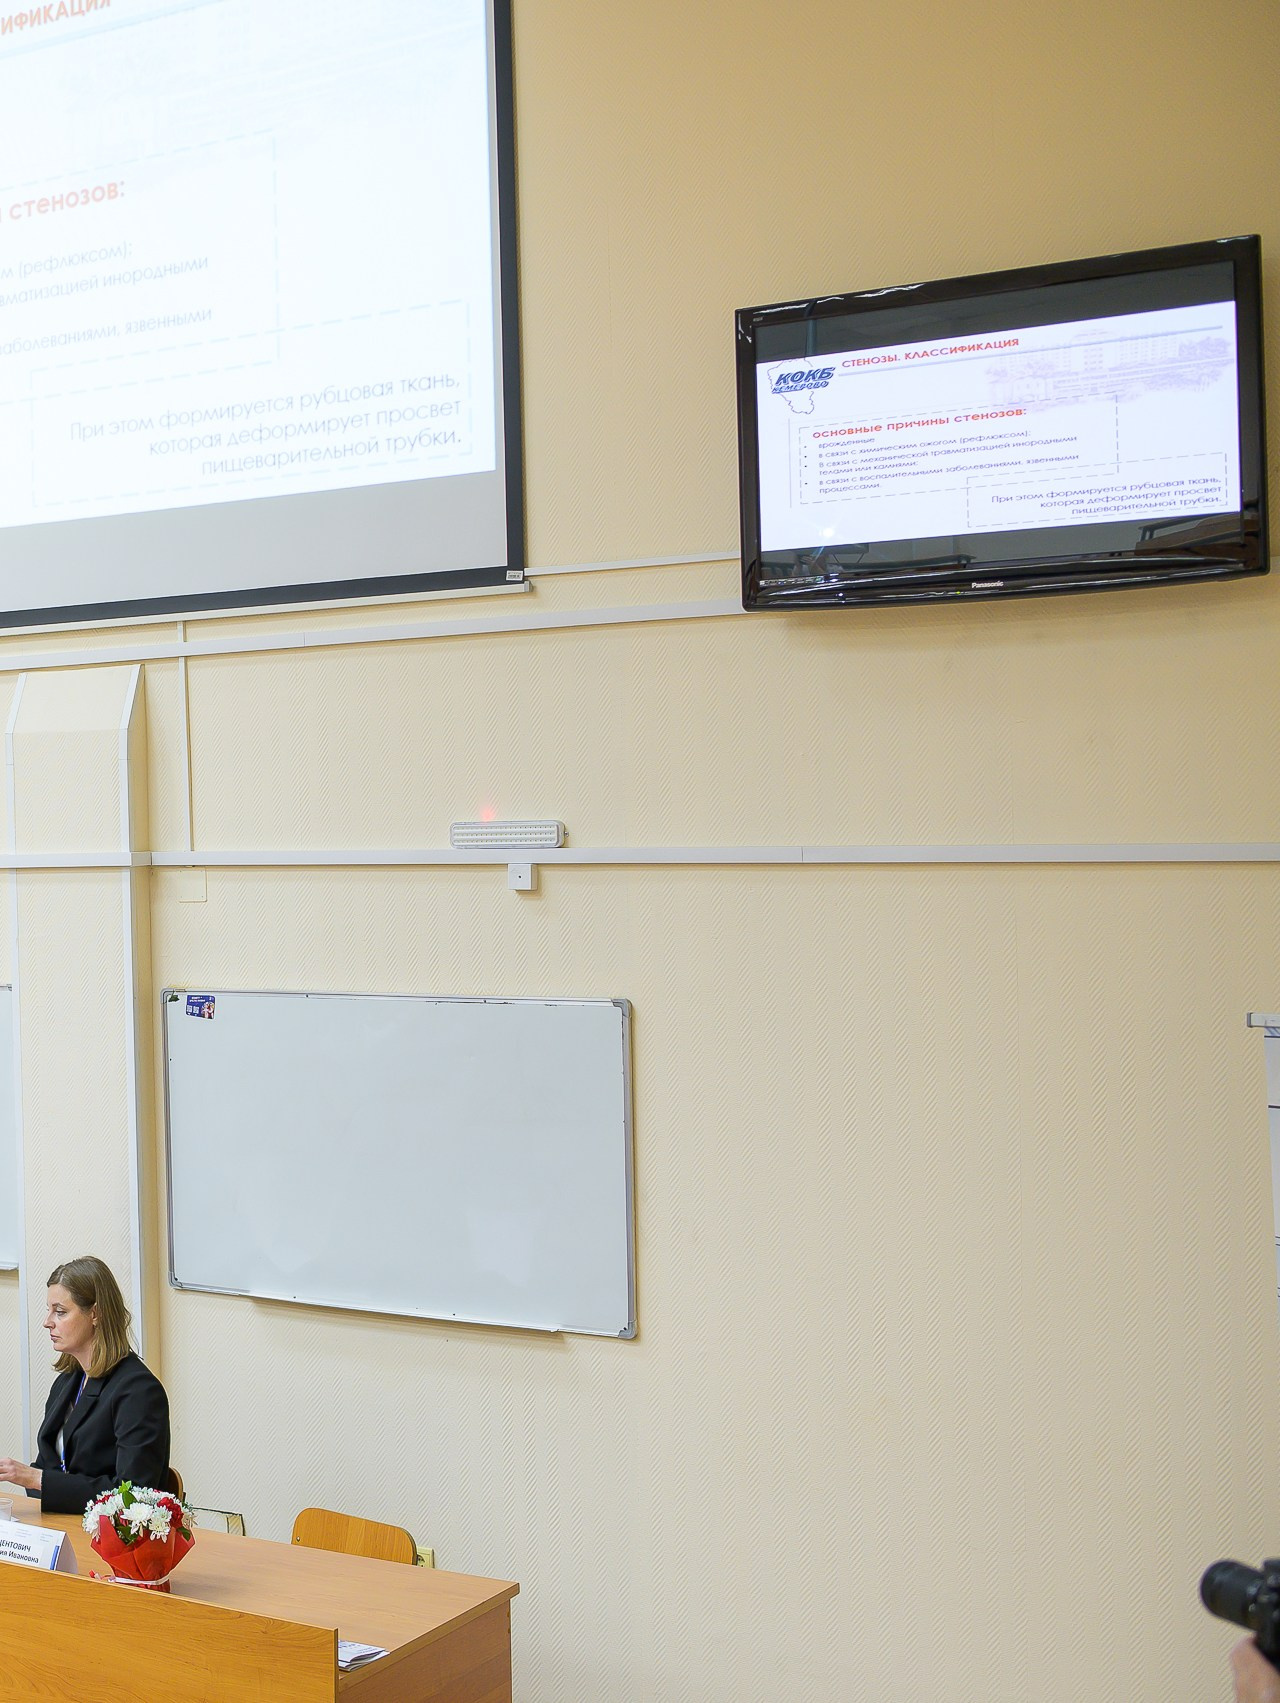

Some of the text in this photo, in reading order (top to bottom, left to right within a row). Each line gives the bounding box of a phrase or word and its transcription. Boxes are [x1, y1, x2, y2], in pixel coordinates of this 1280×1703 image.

[9, 180, 125, 220] стенозов:
[19, 240, 132, 279] (рефлюксом);
[103, 256, 209, 287] инородными
[124, 308, 213, 335] язвенными
[841, 338, 1020, 368] СТЕНОЗЫ. КЛАССИФИКАЦИЯ
[774, 366, 836, 386] КОКБ
[70, 373, 460, 443] При этом формируется рубцовая ткань,
[149, 400, 462, 457] которая деформирует просвет
[812, 408, 1027, 439] основные причины стенозов:
[201, 427, 462, 476] пищеварительной трубки.
[991, 476, 1222, 504] При этом формируется рубцовая ткань,
[1040, 486, 1222, 509] которая деформирует просвет
[1071, 496, 1221, 515] пищеварительной трубки.
[971, 580, 1004, 589] Panasonic
[8, 1550, 39, 1564] Ивановна
